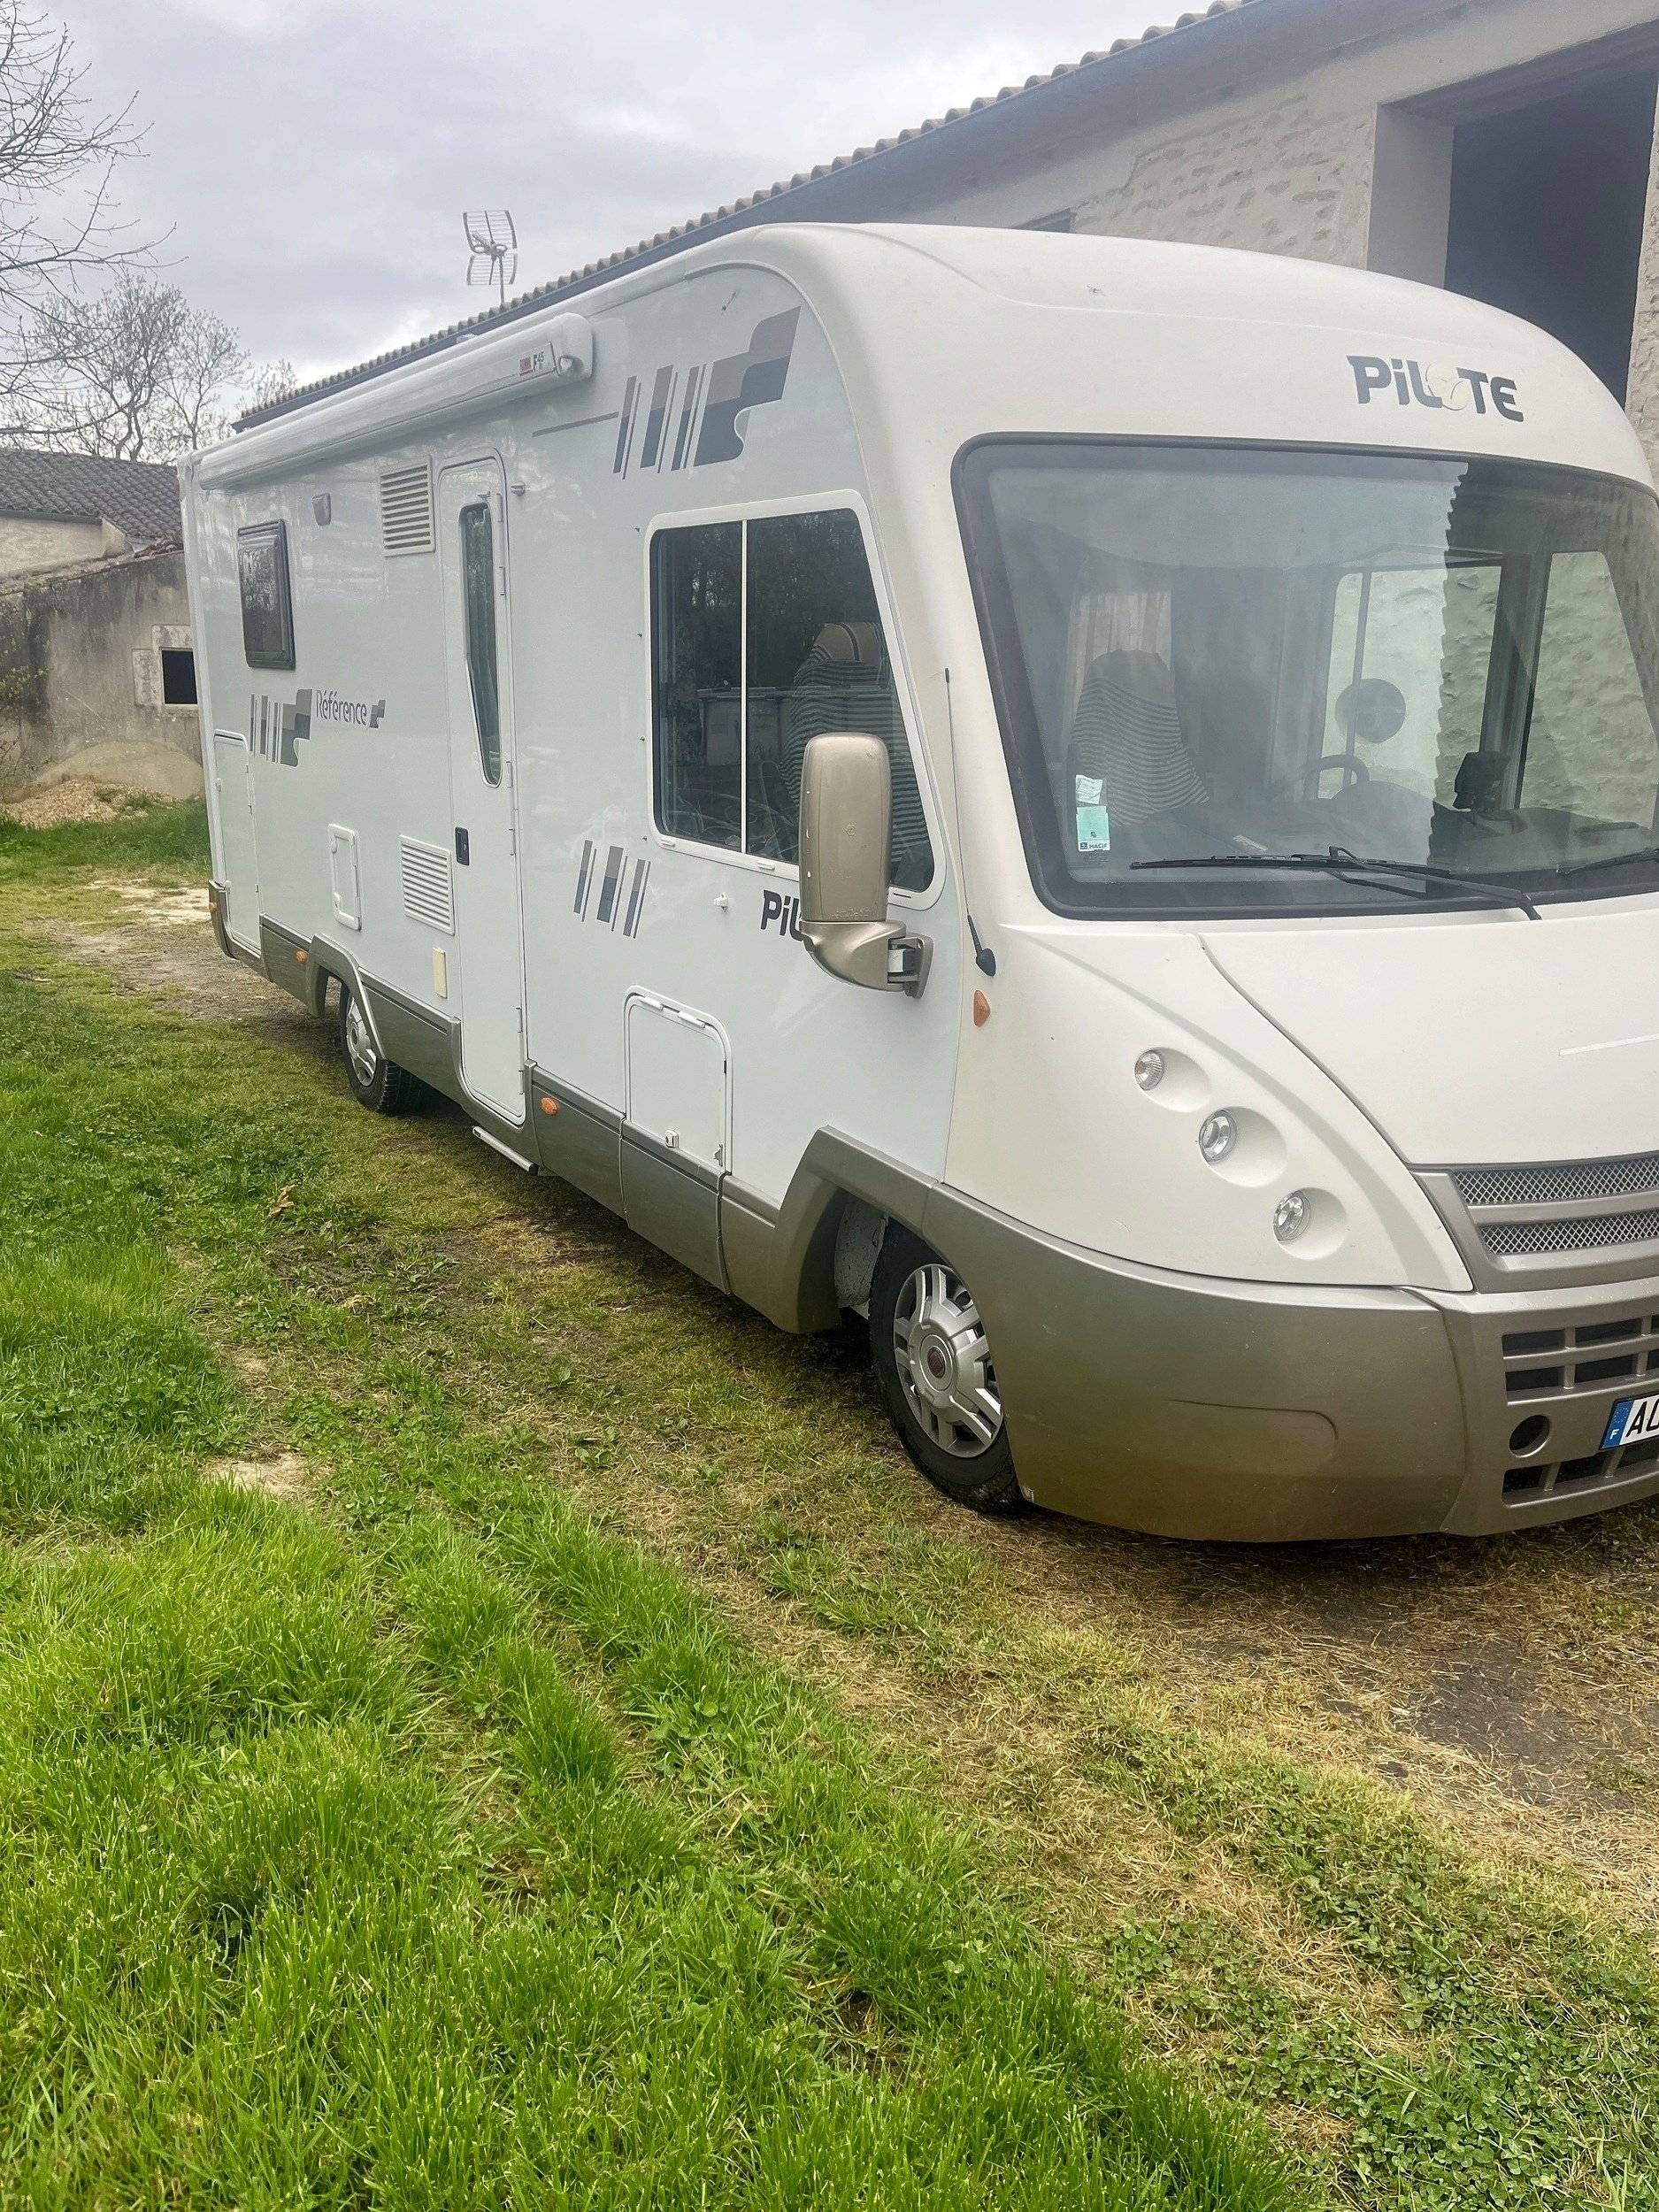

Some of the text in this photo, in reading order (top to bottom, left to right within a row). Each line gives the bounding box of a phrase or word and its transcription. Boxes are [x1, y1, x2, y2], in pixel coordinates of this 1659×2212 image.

[316, 689, 367, 726] Référence
[760, 889, 804, 941] PiL
[1609, 1428, 1620, 1440] F
